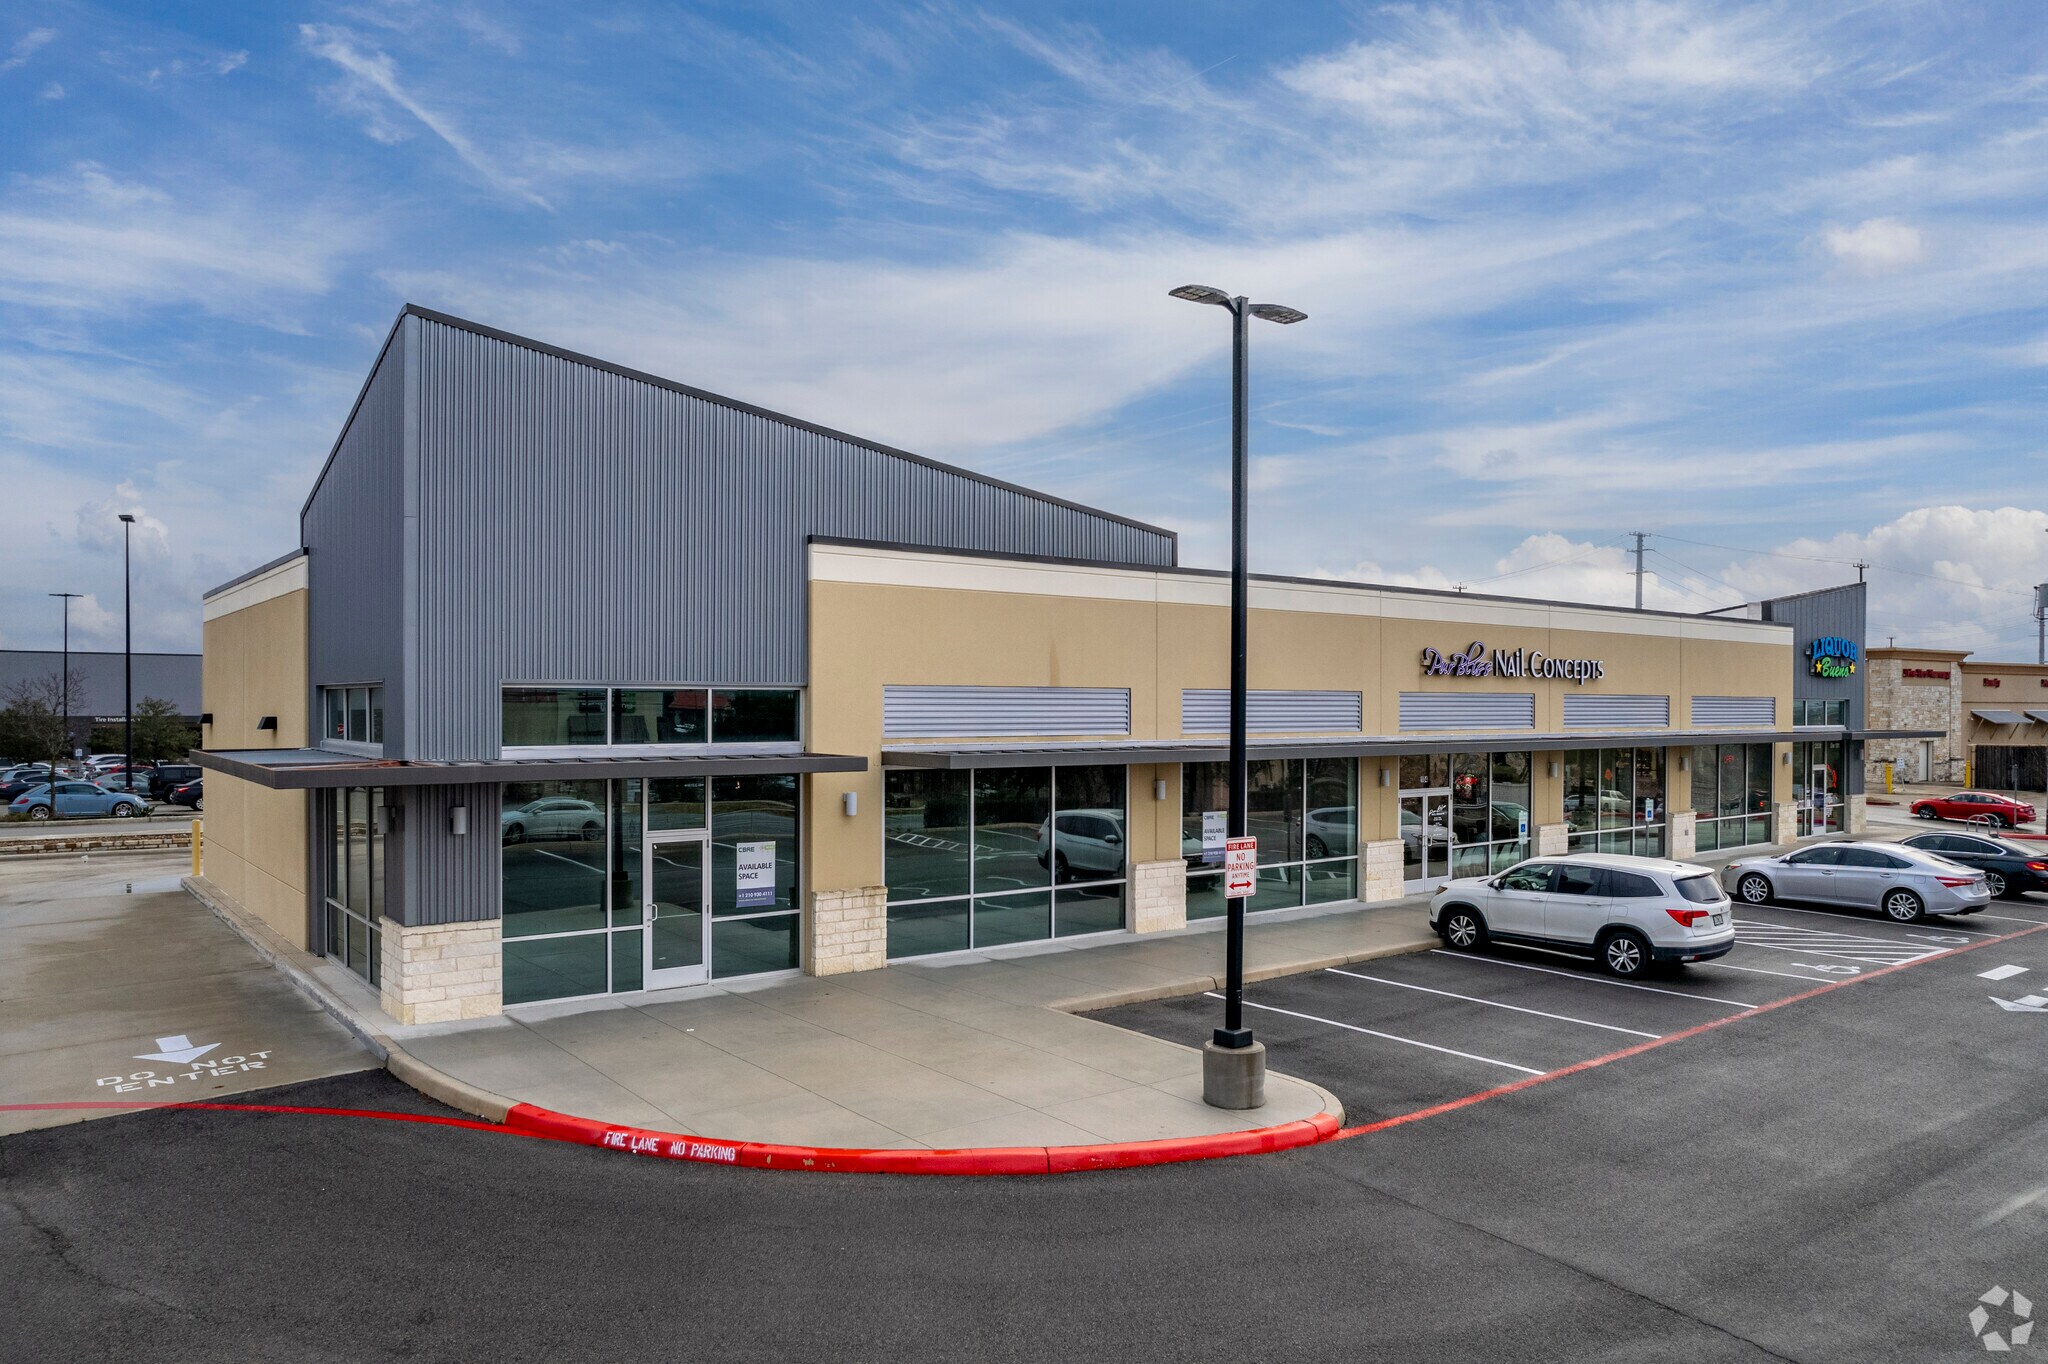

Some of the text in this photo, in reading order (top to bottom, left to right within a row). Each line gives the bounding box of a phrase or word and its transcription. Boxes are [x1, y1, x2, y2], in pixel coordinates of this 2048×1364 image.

[1812, 636, 1858, 662] LIQUOR
[1822, 657, 1849, 678] Bueno
[738, 862, 772, 871] AVAILABLE
[1227, 862, 1254, 872] PARKING
[1236, 852, 1246, 861] NO
[738, 872, 758, 880] SPACE
[96, 1050, 272, 1087] DO NOT
[114, 1061, 267, 1094] ENTER
[604, 1131, 736, 1161] FIRE LANE NO PARKING
